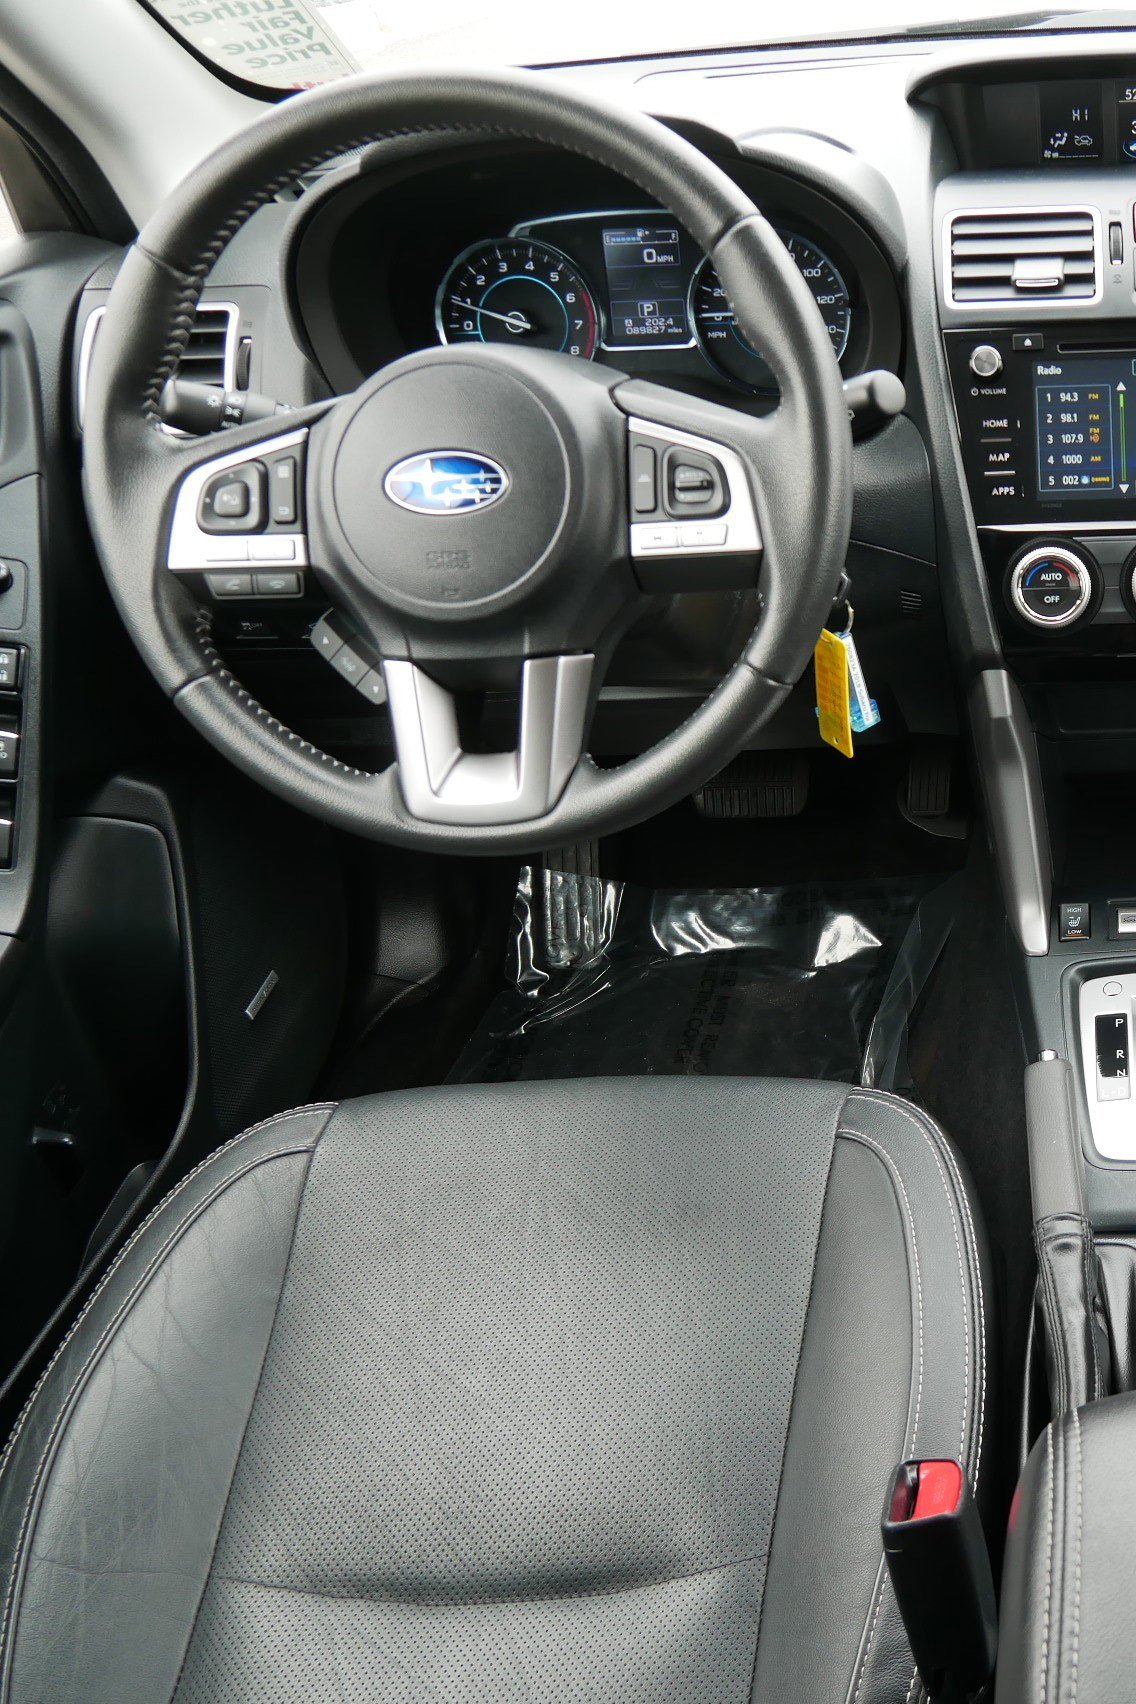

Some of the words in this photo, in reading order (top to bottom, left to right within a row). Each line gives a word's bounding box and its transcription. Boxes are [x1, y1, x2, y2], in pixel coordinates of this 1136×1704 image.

[643, 248, 657, 265] 0
[657, 254, 674, 263] MPH
[498, 262, 508, 273] 3
[524, 261, 535, 271] 4
[549, 271, 560, 282] 5
[802, 268, 821, 278] 100
[476, 275, 486, 286] 2
[566, 293, 576, 303] 6
[816, 295, 835, 304] 120
[643, 304, 653, 316] P
[463, 320, 473, 331] 0
[574, 320, 583, 331] 7
[626, 326, 666, 335] 089827
[707, 331, 727, 339] MPH
[571, 345, 580, 356] 8
[1036, 365, 1062, 375] Radio
[980, 387, 1007, 395] VOLUME
[1046, 393, 1051, 402] 1
[1059, 392, 1079, 402] 94.3
[1046, 413, 1053, 423] 2
[1060, 413, 1078, 423] 98.1
[982, 419, 1009, 428] HOME
[1047, 434, 1054, 444] 3
[1061, 433, 1084, 444] 107.9
[988, 453, 1011, 462] MAP
[1047, 455, 1054, 465] 4
[1062, 454, 1083, 465] 1000
[1048, 475, 1055, 485] 5
[1062, 475, 1079, 485] 002
[991, 486, 1015, 496] APPS
[1040, 571, 1063, 582] AUTO
[1043, 594, 1060, 604] OFF
[1115, 1018, 1124, 1028] P
[1116, 1049, 1125, 1059] R
[1116, 1068, 1126, 1077] N
